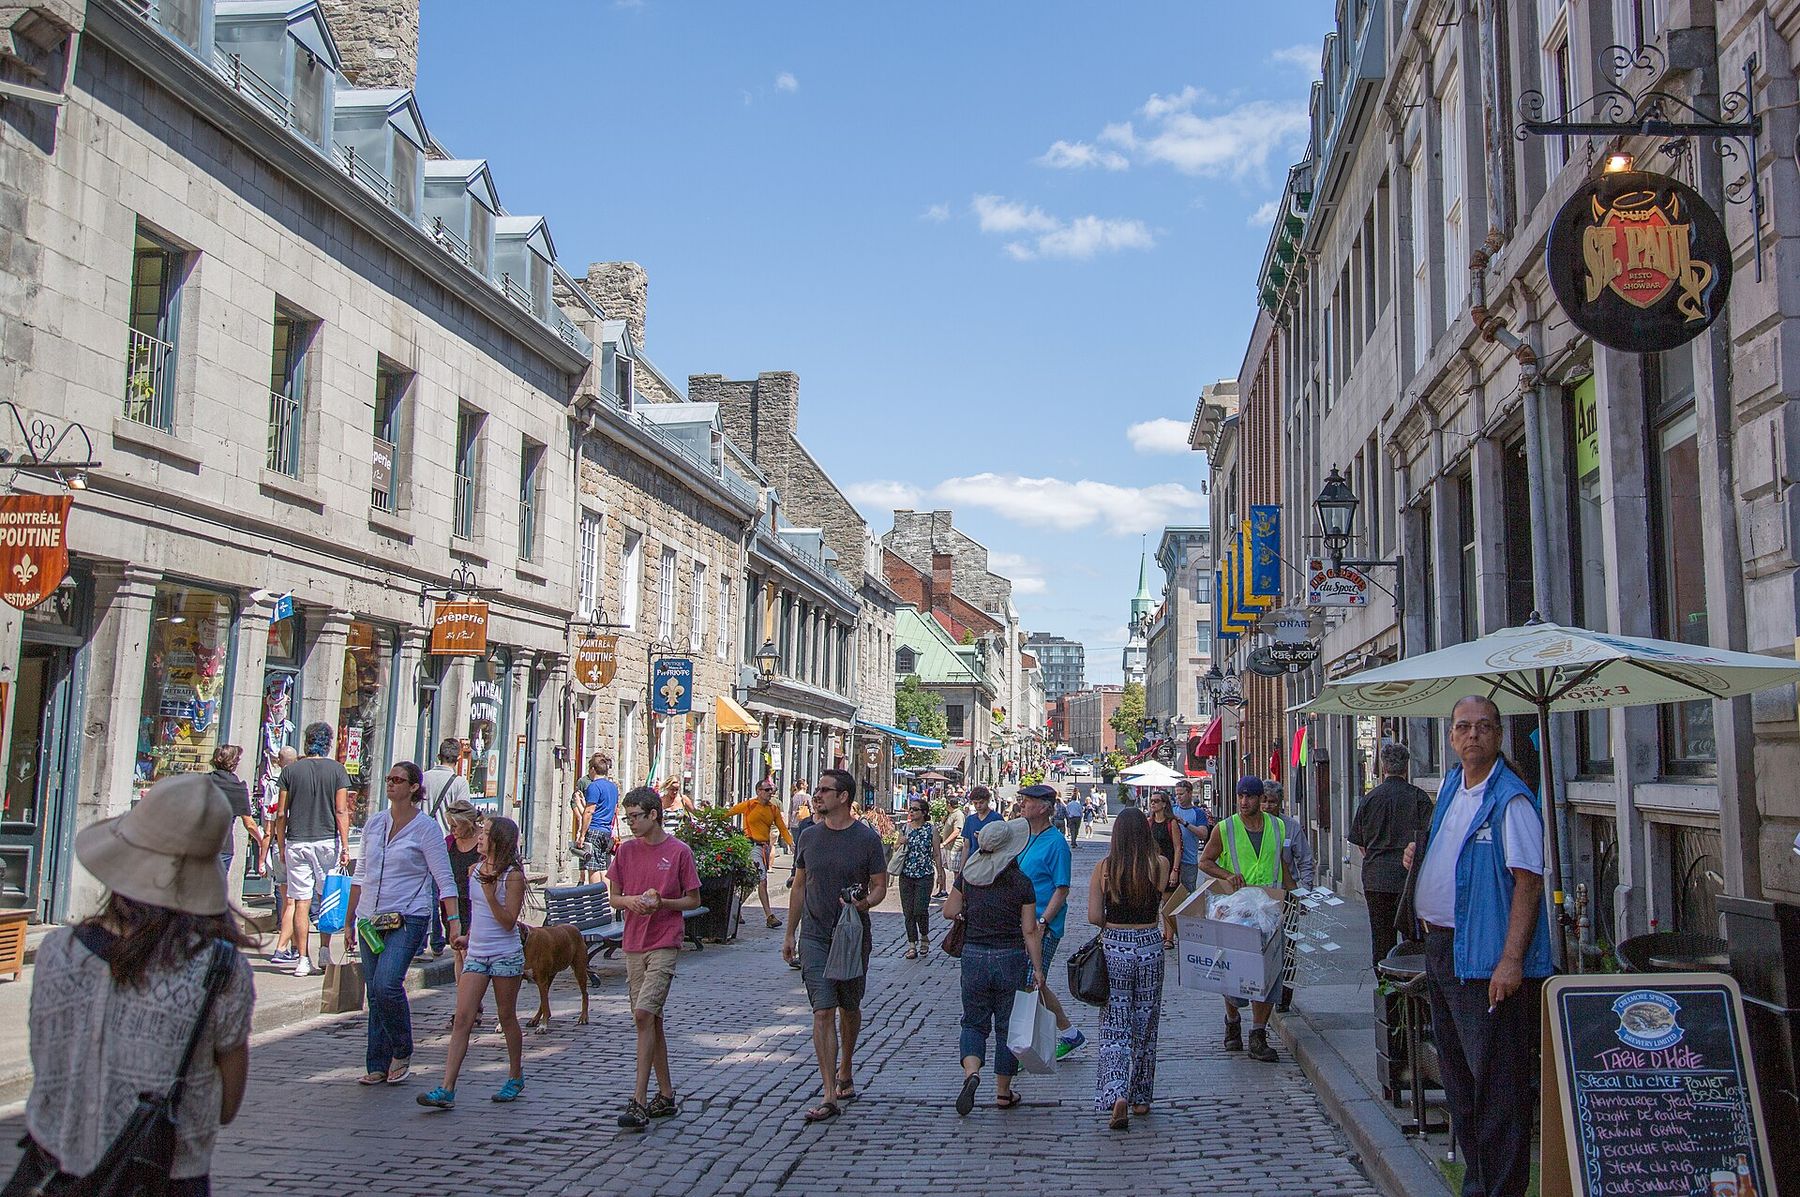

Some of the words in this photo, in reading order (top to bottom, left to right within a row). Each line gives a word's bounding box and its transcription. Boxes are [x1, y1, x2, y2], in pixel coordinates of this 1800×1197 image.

[1620, 211, 1651, 221] PUB
[1624, 224, 1701, 307] PAUL
[1623, 281, 1661, 290] SHOWBAR
[0, 510, 61, 525] MONTRÉAL
[0, 528, 61, 547] POUTINE
[1320, 582, 1332, 592] du
[1332, 581, 1359, 596] Sport
[435, 611, 484, 625] crêperie
[1274, 620, 1312, 628] SONART
[580, 652, 613, 662] POUTINE
[1187, 954, 1231, 970] GILDAN
[1649, 994, 1673, 1008] SPRINGS
[1623, 1034, 1653, 1047] BREWERY
[1654, 1033, 1677, 1047] LIMITED
[1594, 1047, 1646, 1071] TABLE
